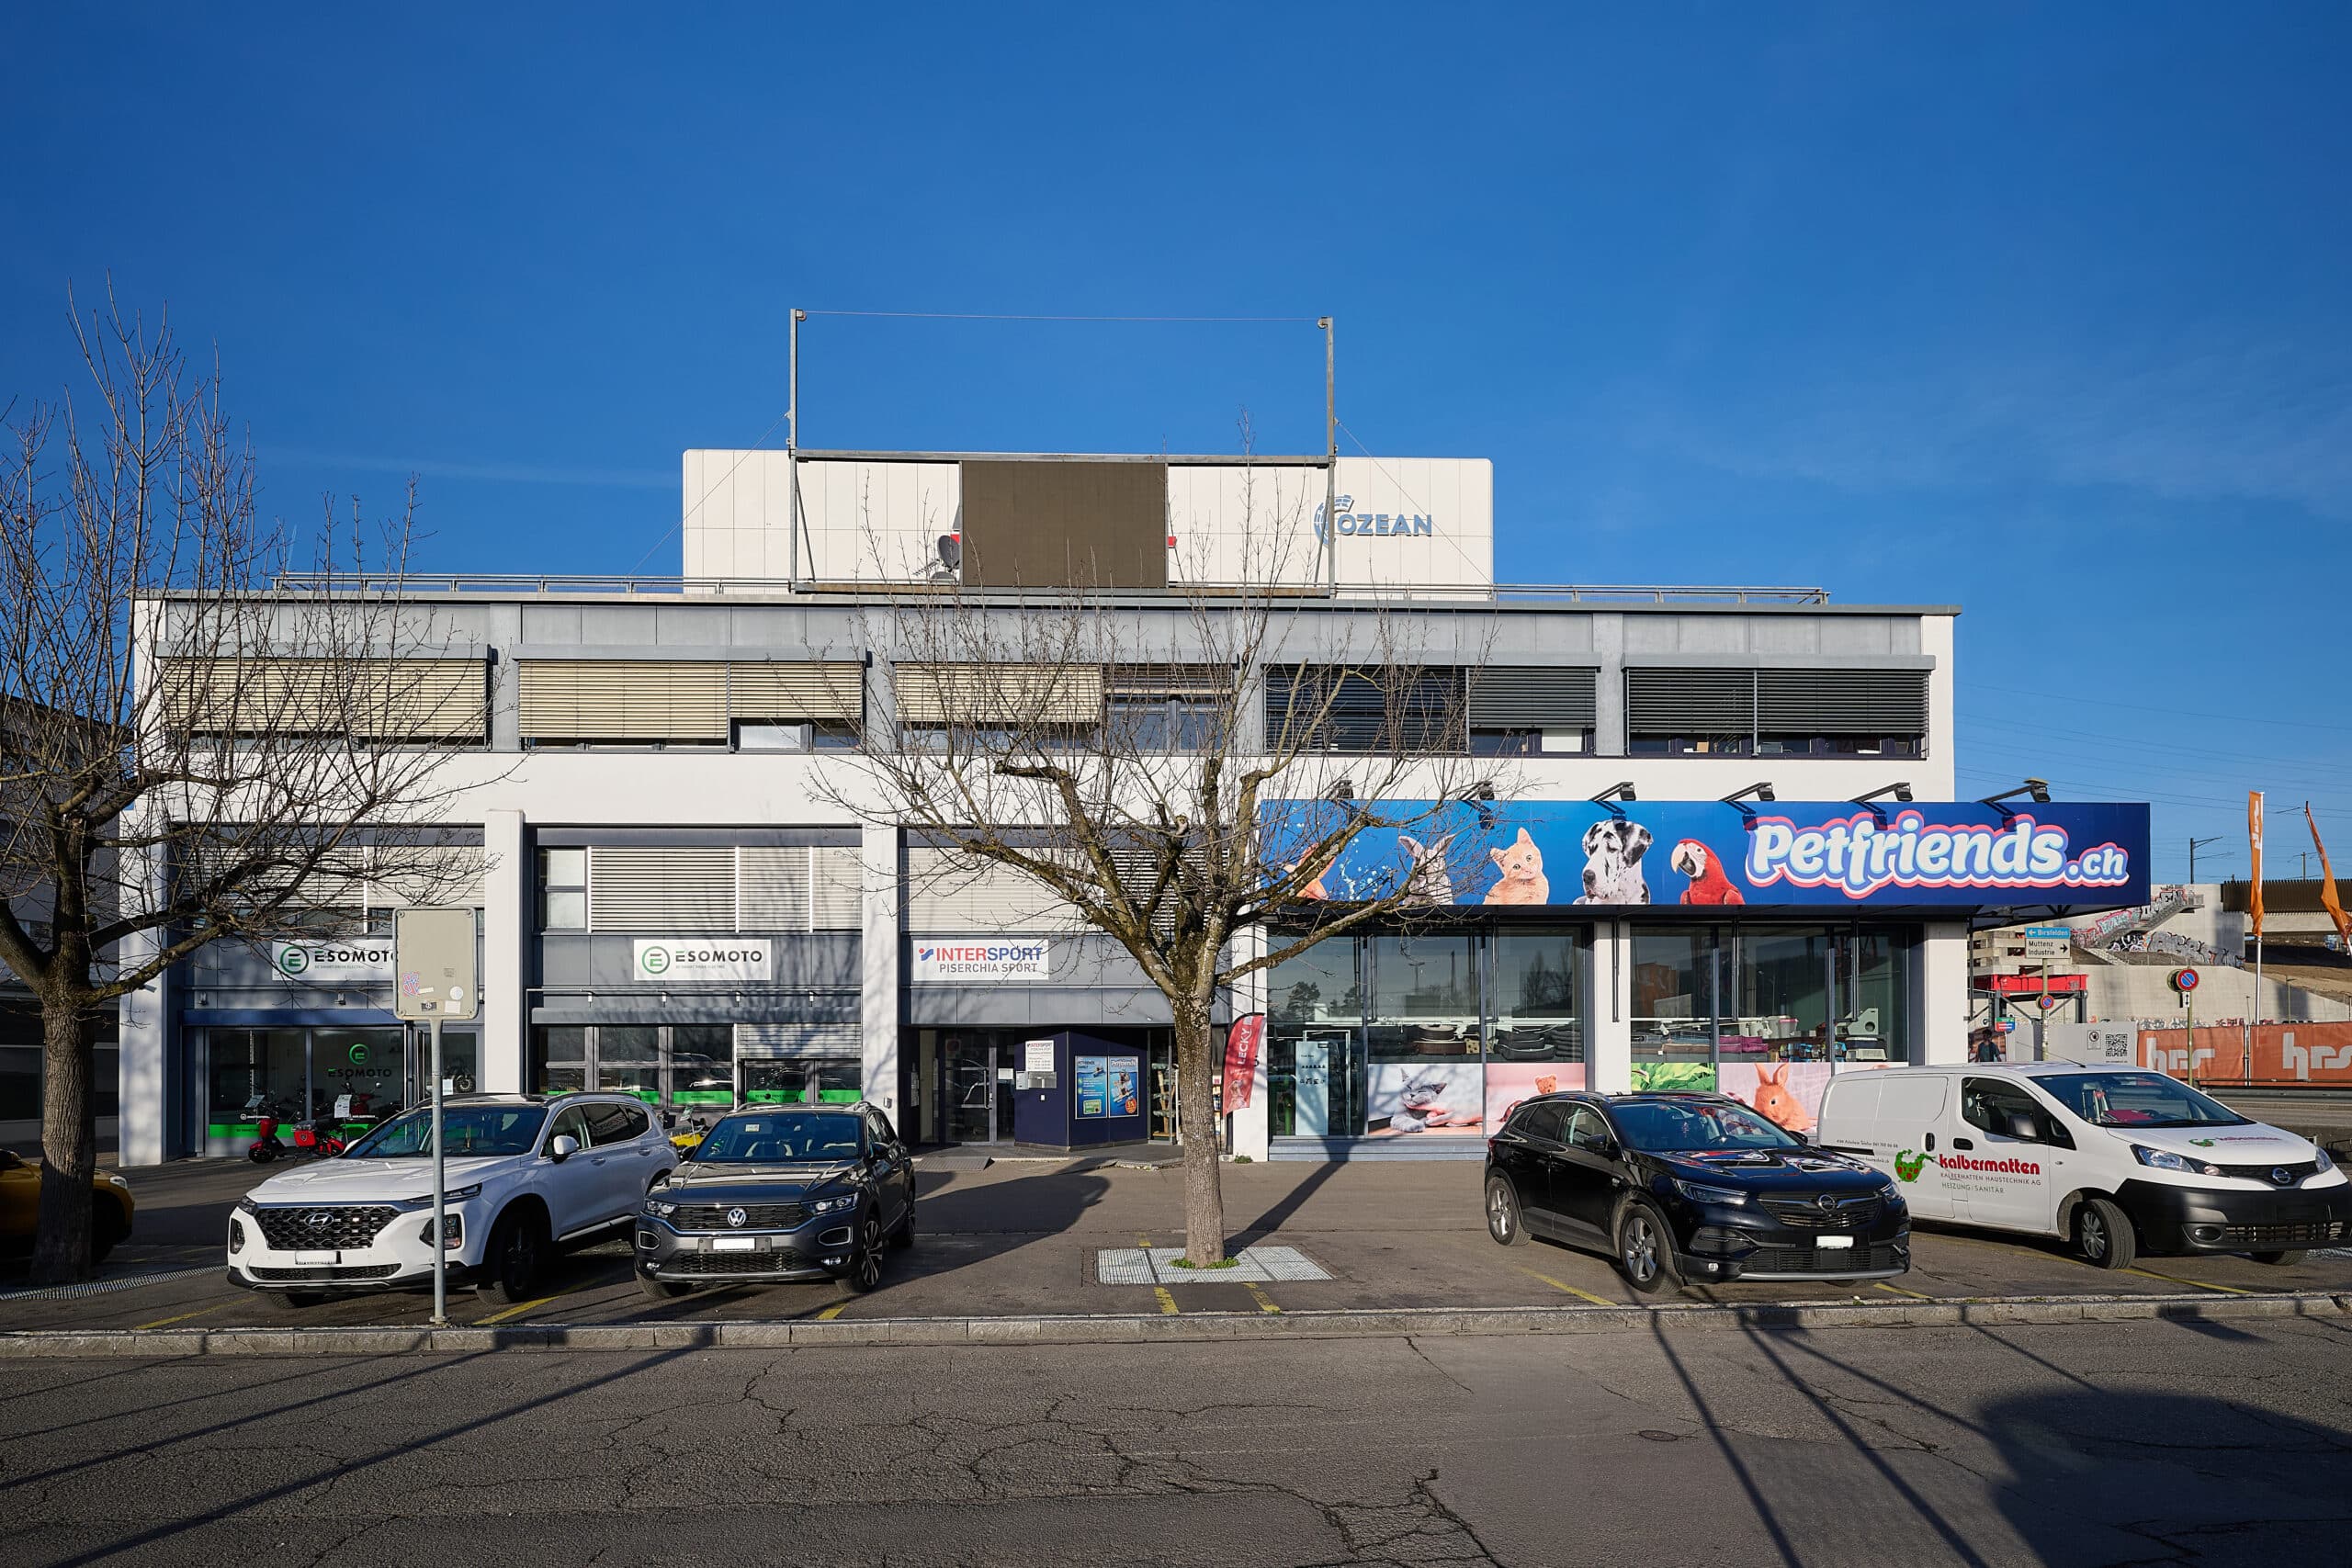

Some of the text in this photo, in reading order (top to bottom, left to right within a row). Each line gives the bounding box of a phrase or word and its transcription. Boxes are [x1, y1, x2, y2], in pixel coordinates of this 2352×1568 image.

[1338, 514, 1432, 536] OZEAN
[1748, 817, 2129, 887] Petfriends.ch
[314, 950, 394, 963] ESOMOT
[675, 950, 763, 963] ESOMOTO
[936, 947, 1044, 962] INTERSPORT
[939, 963, 1038, 973] PISERCHIA SPORT
[328, 1068, 392, 1077] ESOMOTO
[1939, 1153, 2041, 1175] kalbermatten
[1940, 1172, 1984, 1181] KALBERMATTEN
[1985, 1177, 2030, 1185] HAUSTECHNIK
[1942, 1182, 1971, 1190] HEIZUNG
